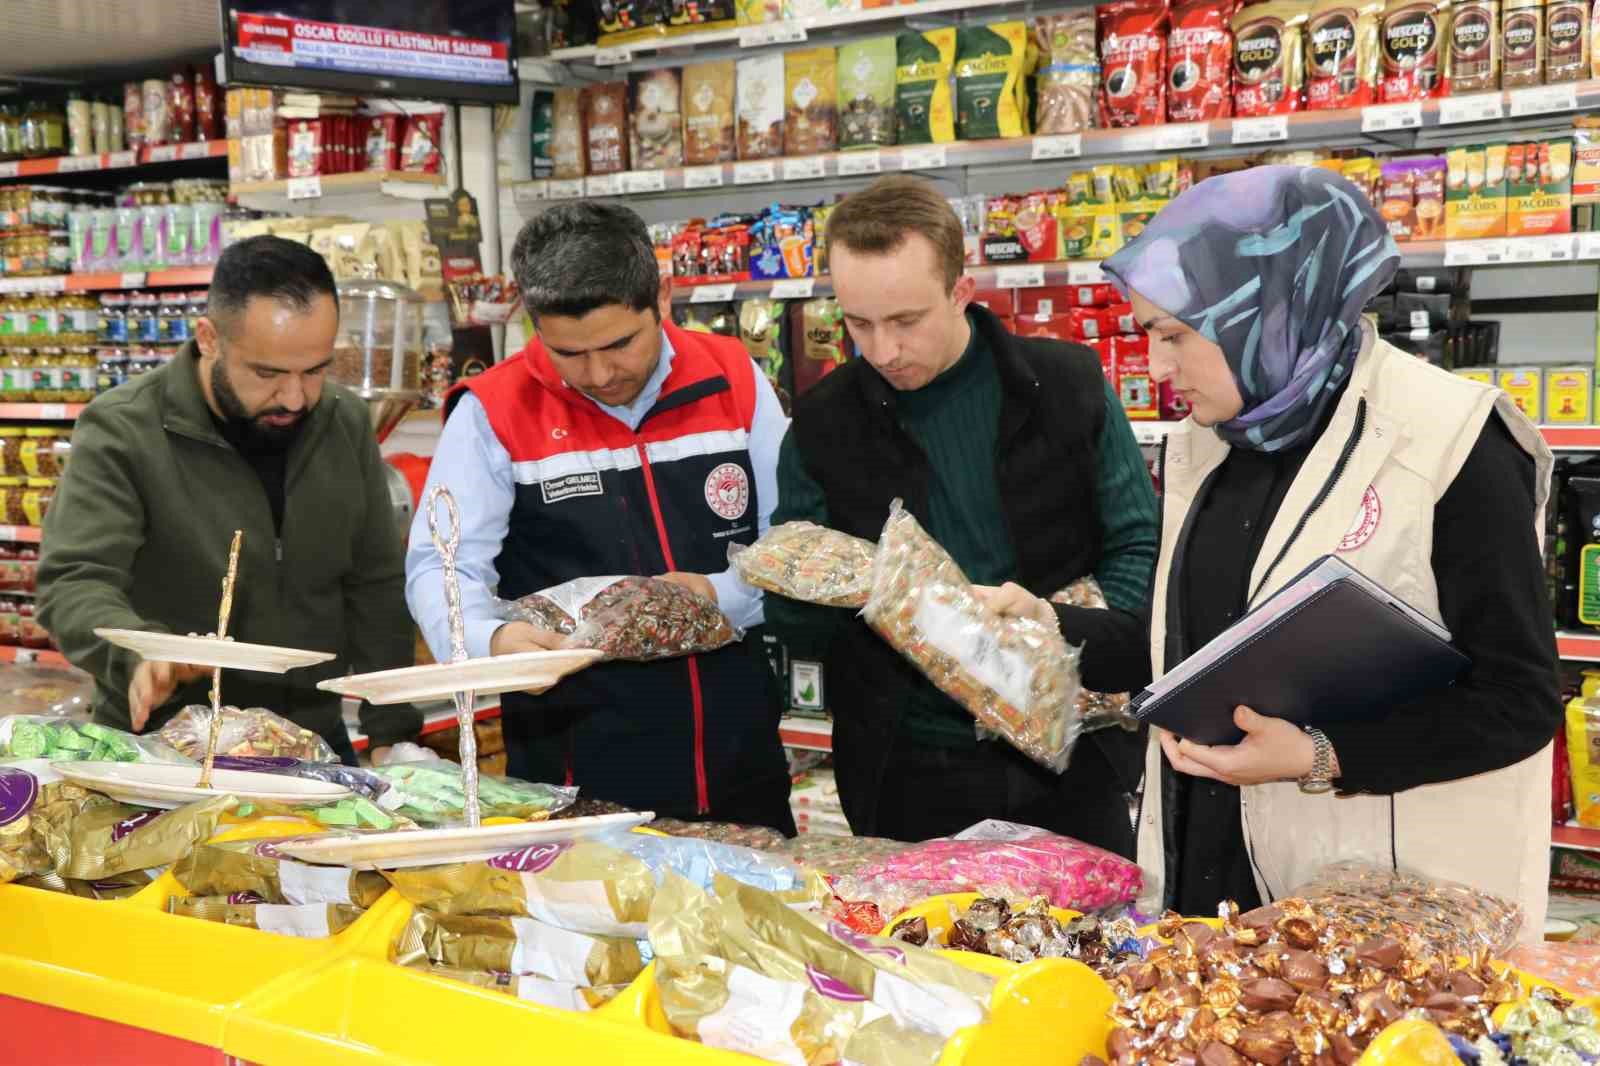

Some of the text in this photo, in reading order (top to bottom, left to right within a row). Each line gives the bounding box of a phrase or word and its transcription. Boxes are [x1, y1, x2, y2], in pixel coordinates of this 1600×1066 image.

[294, 24, 335, 40] OSCAR
[1457, 32, 1485, 43] GOLD
[1391, 34, 1429, 50] GOLD
[1240, 47, 1274, 63] GOLD
[1455, 201, 1497, 212] JACOBS
[1517, 198, 1561, 210] JACOBS
